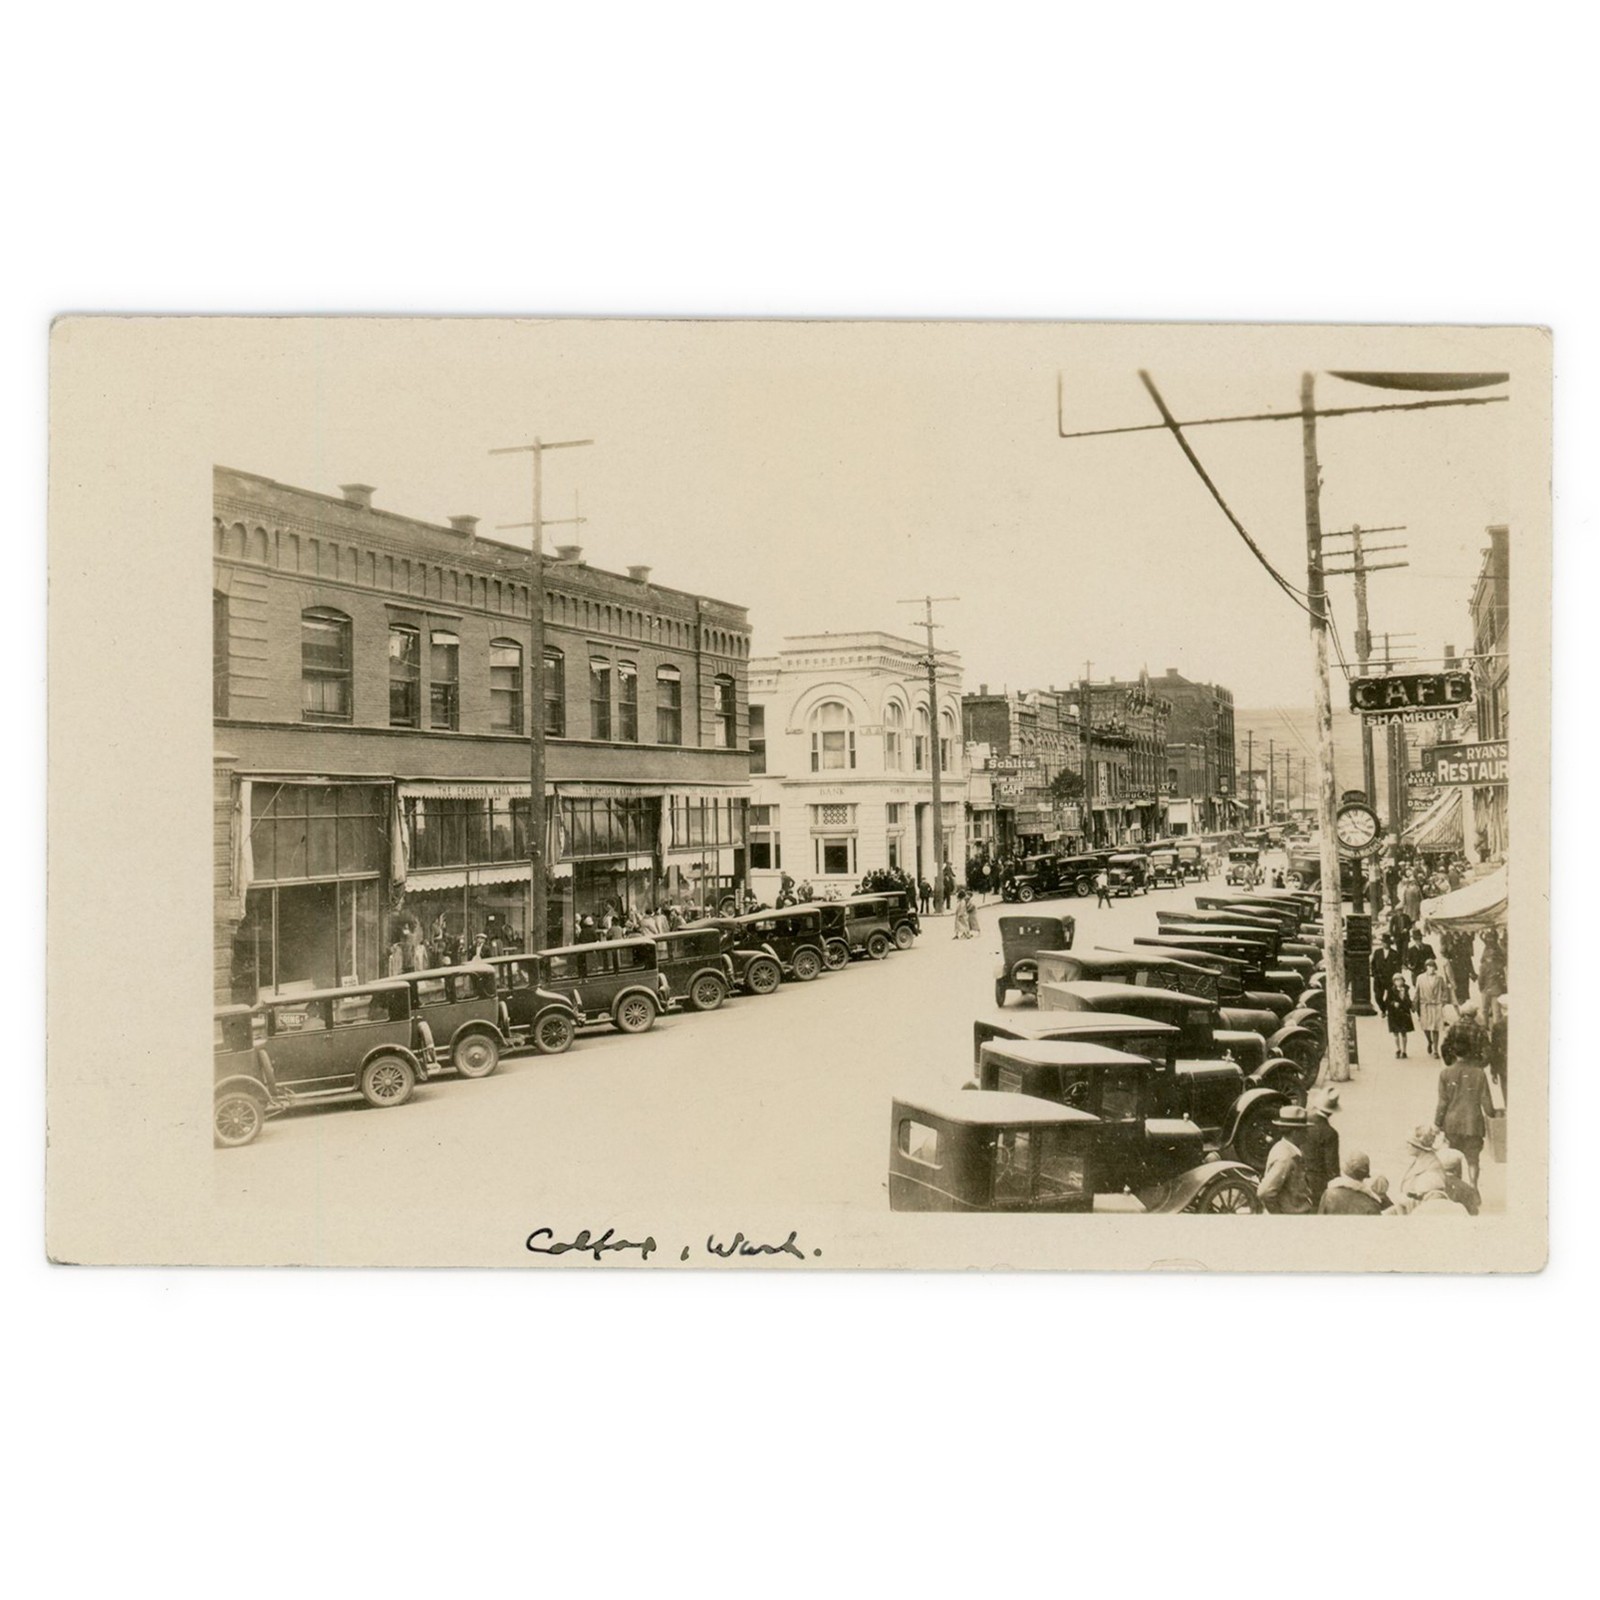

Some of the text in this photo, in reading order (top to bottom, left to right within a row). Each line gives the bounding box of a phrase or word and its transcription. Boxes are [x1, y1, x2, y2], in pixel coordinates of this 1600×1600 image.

[1355, 676, 1466, 707] CAFE
[1366, 710, 1456, 727] SHAMROCK
[1466, 744, 1508, 760] RYAN'S
[988, 758, 1036, 769] Schlitz
[1437, 759, 1509, 783] RESTAUR
[438, 786, 451, 797] THE
[457, 786, 488, 797] EMERSON
[819, 788, 846, 796] BANK
